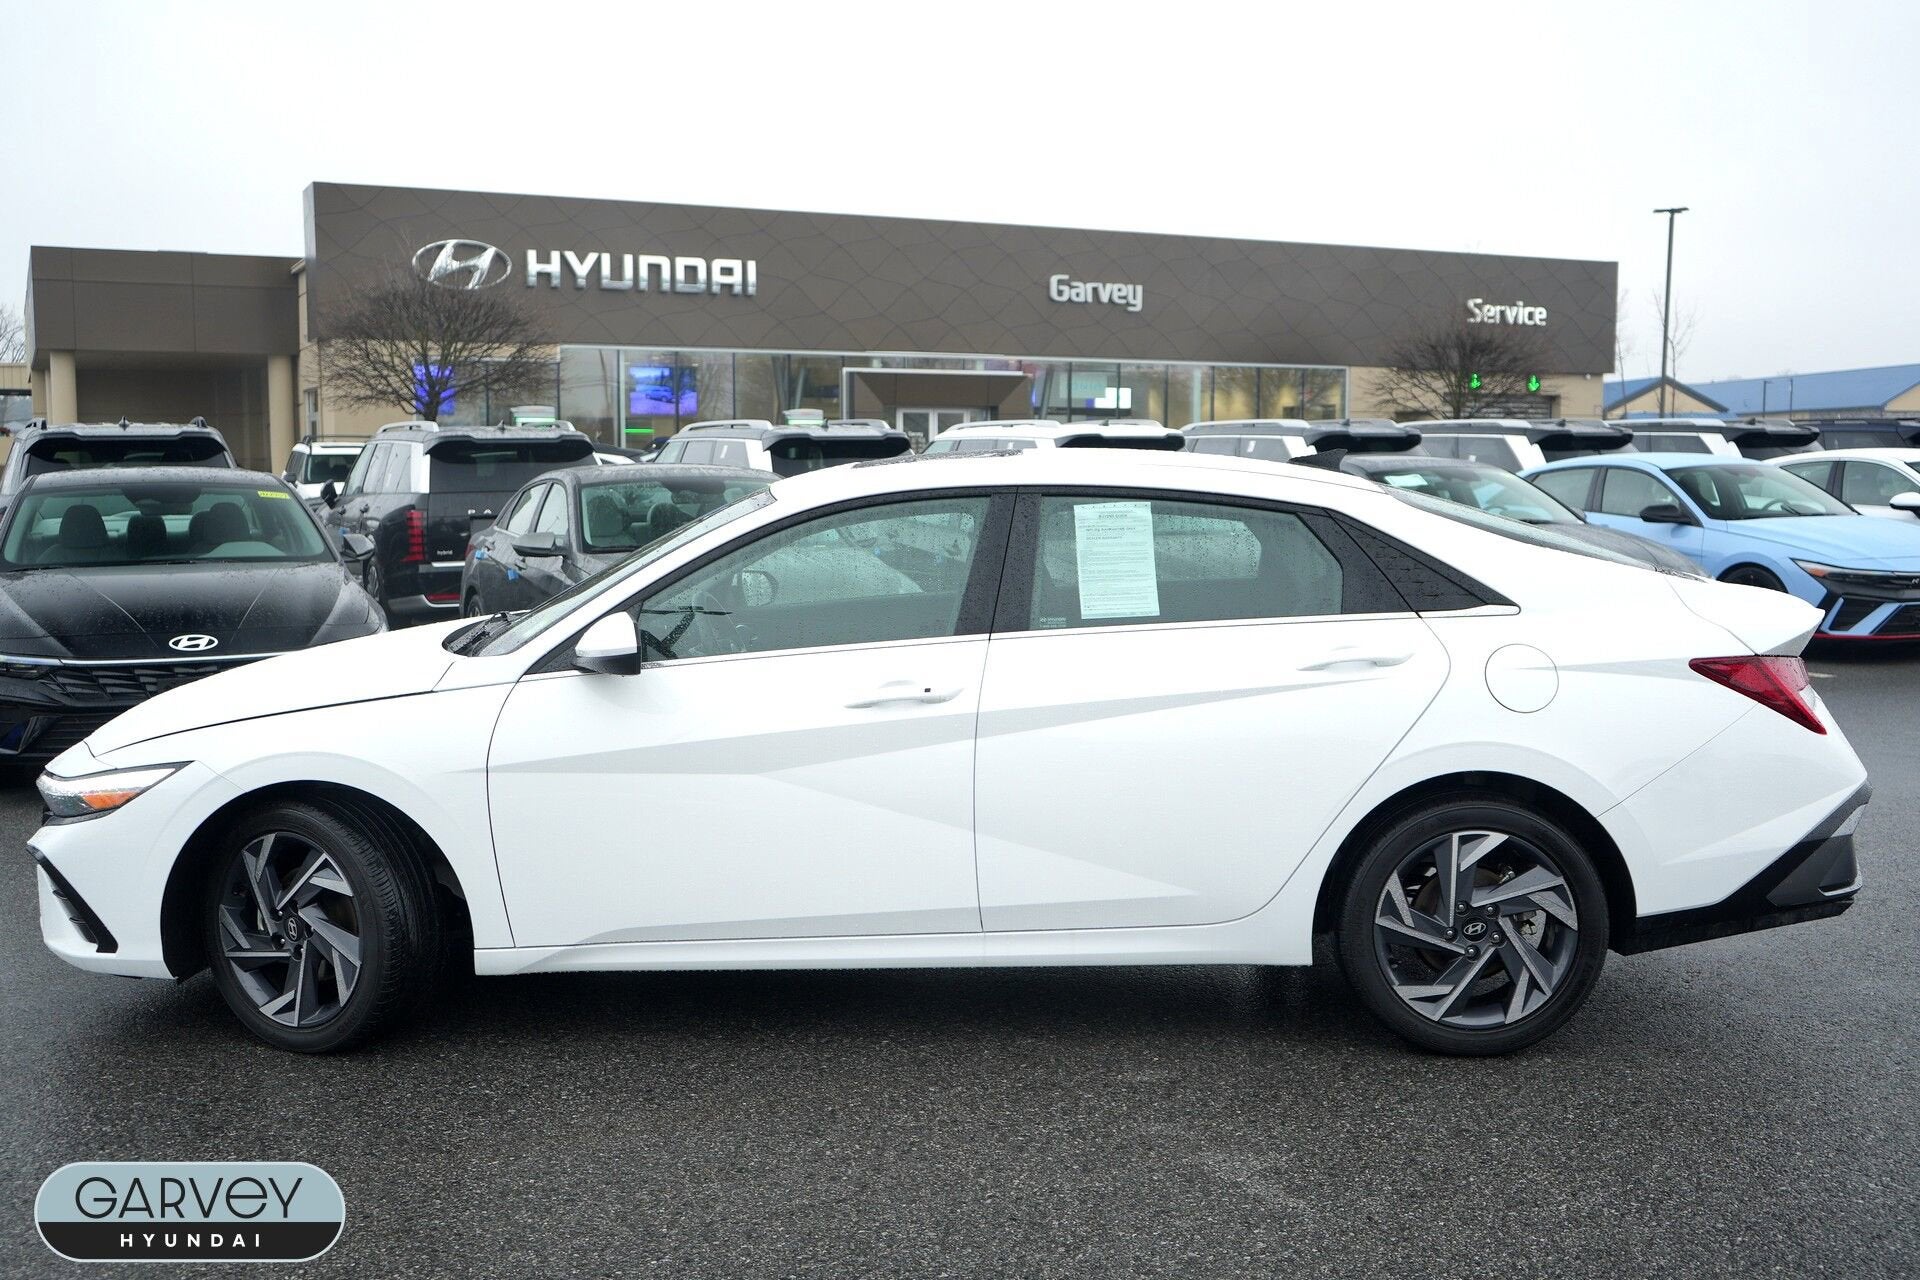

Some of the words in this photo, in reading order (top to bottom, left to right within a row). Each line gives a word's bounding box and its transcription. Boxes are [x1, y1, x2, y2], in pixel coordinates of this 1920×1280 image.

[526, 249, 757, 296] HYUNDAI
[1049, 274, 1143, 312] Garvey
[1466, 298, 1547, 326] Service
